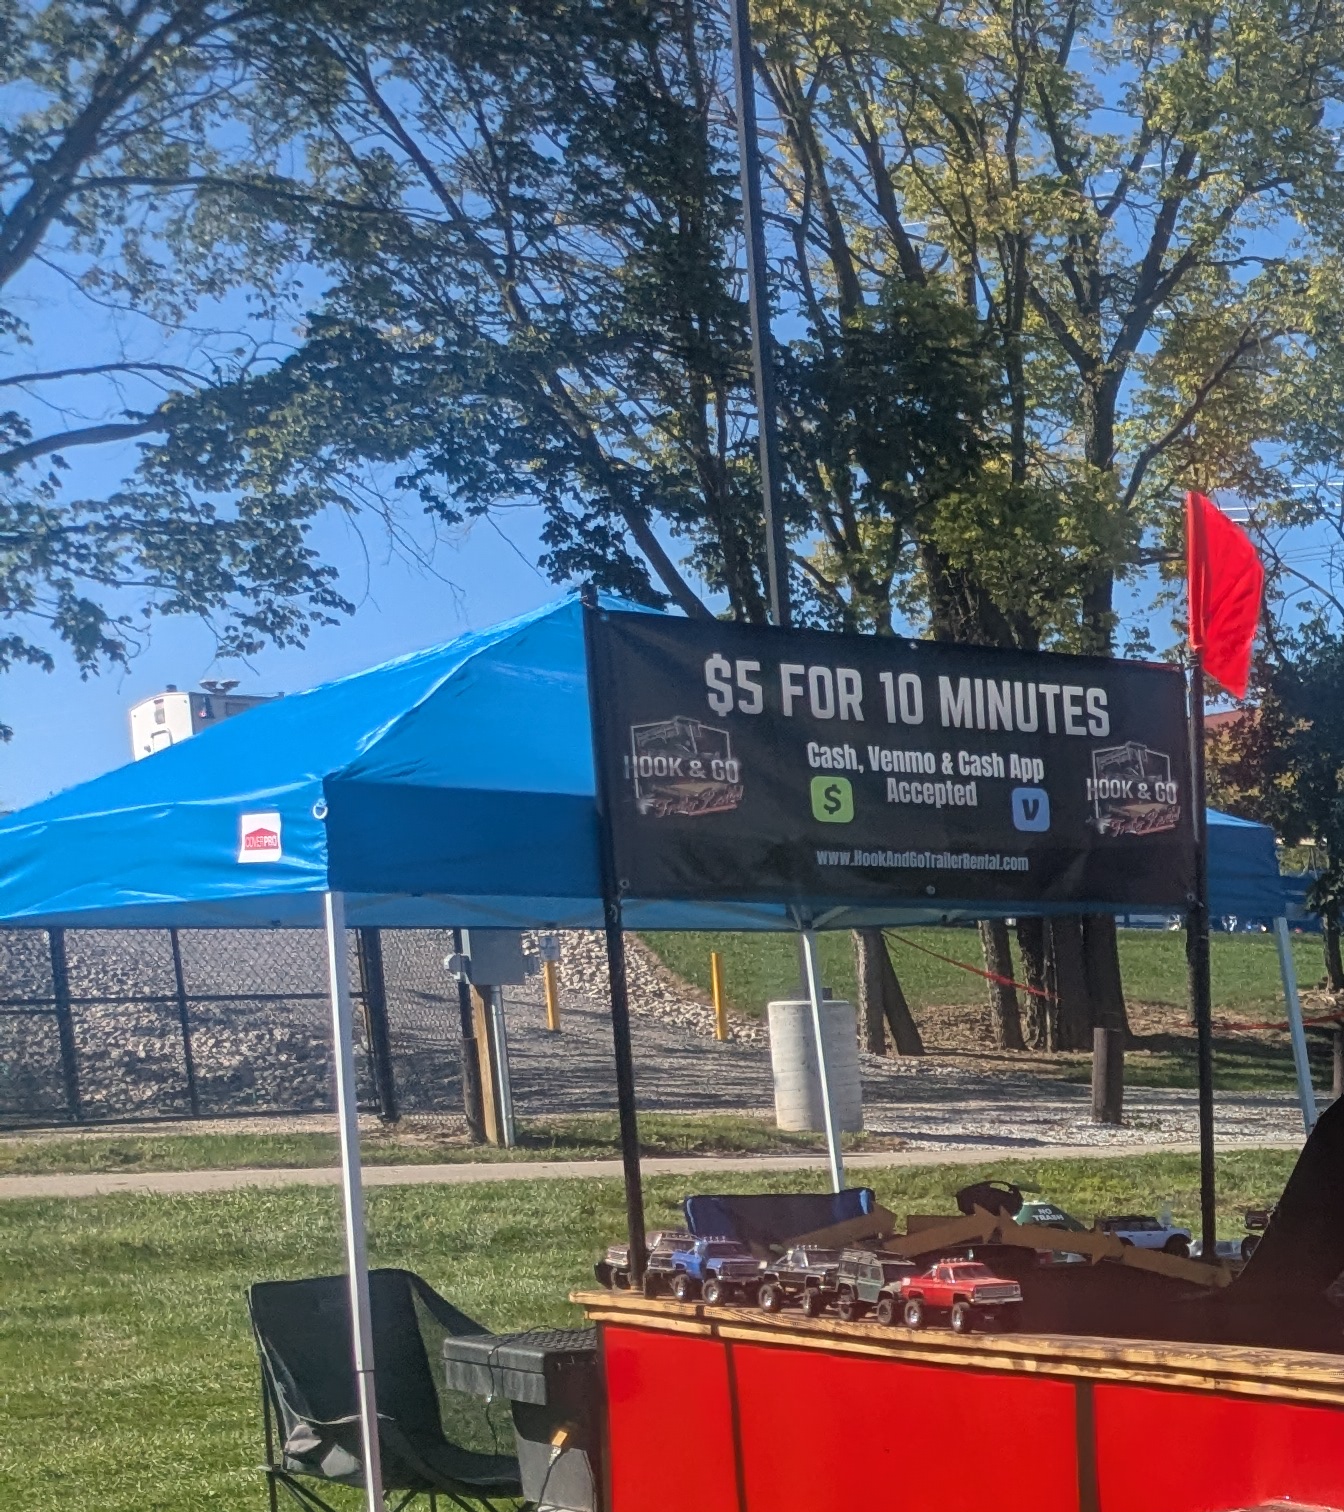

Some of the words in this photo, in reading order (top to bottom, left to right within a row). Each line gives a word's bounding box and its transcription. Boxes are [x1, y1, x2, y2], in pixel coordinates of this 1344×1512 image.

[704, 653, 763, 717] $5
[780, 663, 864, 721] FOR
[880, 671, 923, 724] 10
[939, 675, 1110, 737] MINUTES
[624, 755, 684, 779] HOOK
[689, 760, 707, 779] &
[711, 759, 739, 784] GO
[807, 742, 864, 773] Cash,
[868, 746, 936, 774] Venmo
[942, 752, 954, 775] &
[959, 751, 1005, 778] Cash
[1010, 754, 1044, 783] App
[887, 778, 978, 808] Accepted
[1087, 778, 1133, 801] HOOK
[1138, 783, 1152, 800] &
[1155, 781, 1178, 805] GO
[817, 850, 1029, 871] www.HookAndGoTrailerRental.com
